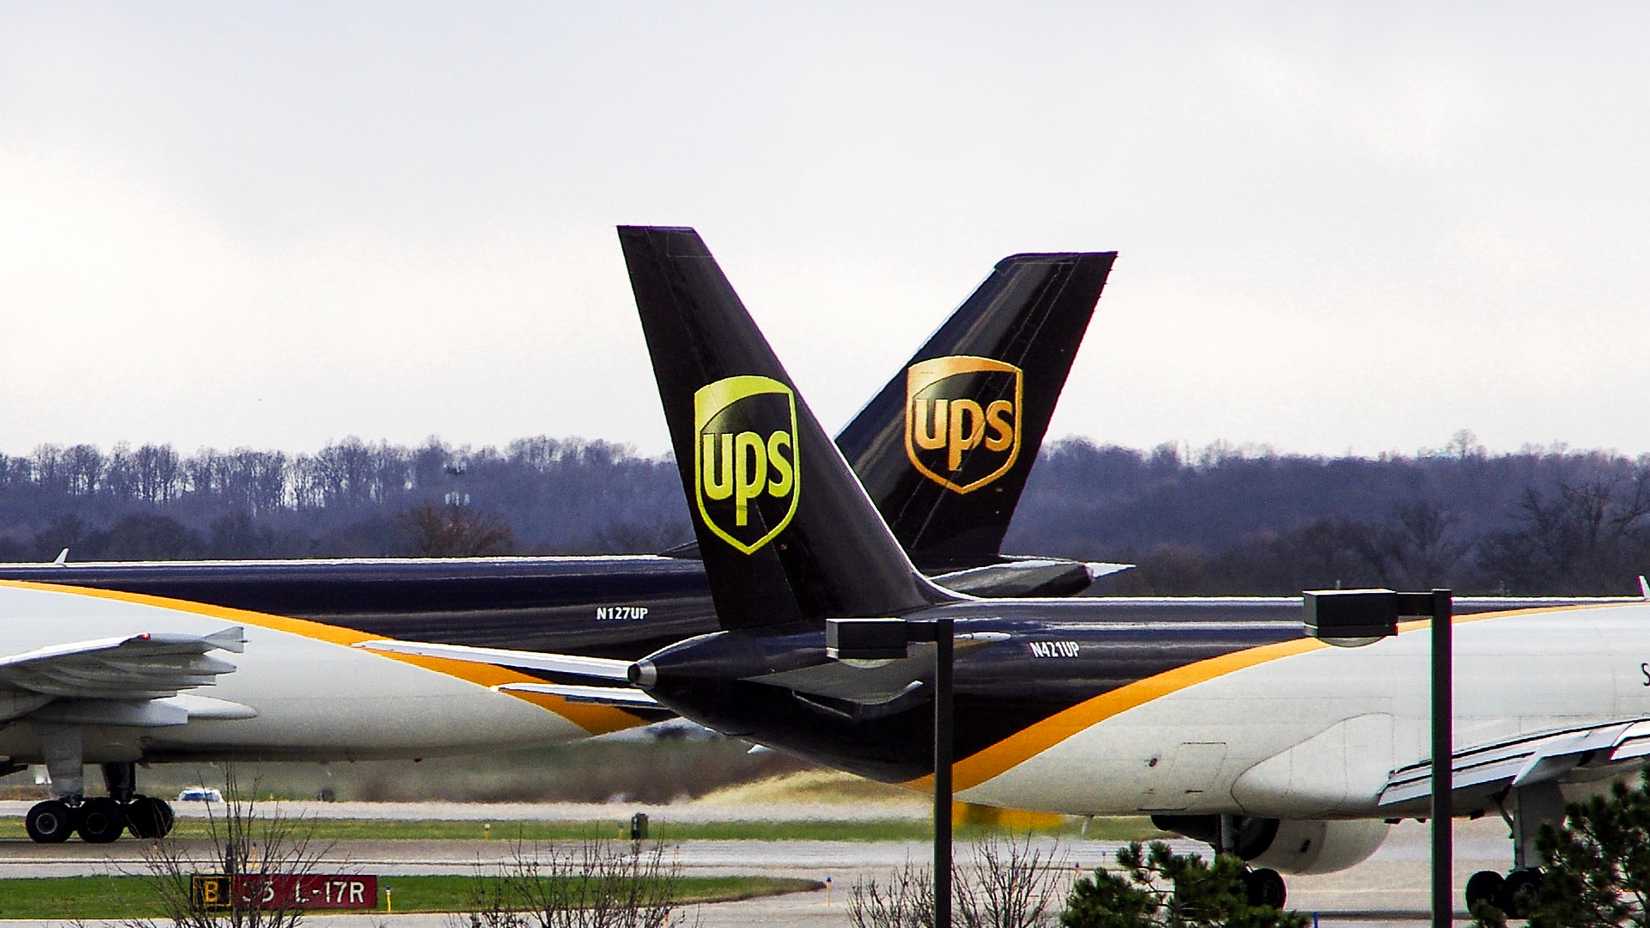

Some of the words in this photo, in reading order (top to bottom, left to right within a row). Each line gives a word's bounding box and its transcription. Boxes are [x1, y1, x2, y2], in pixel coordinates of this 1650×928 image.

[914, 399, 1014, 471] ups
[703, 430, 793, 526] ups
[596, 606, 648, 620] N127UP
[1029, 641, 1080, 657] N421UP
[204, 880, 218, 903] B
